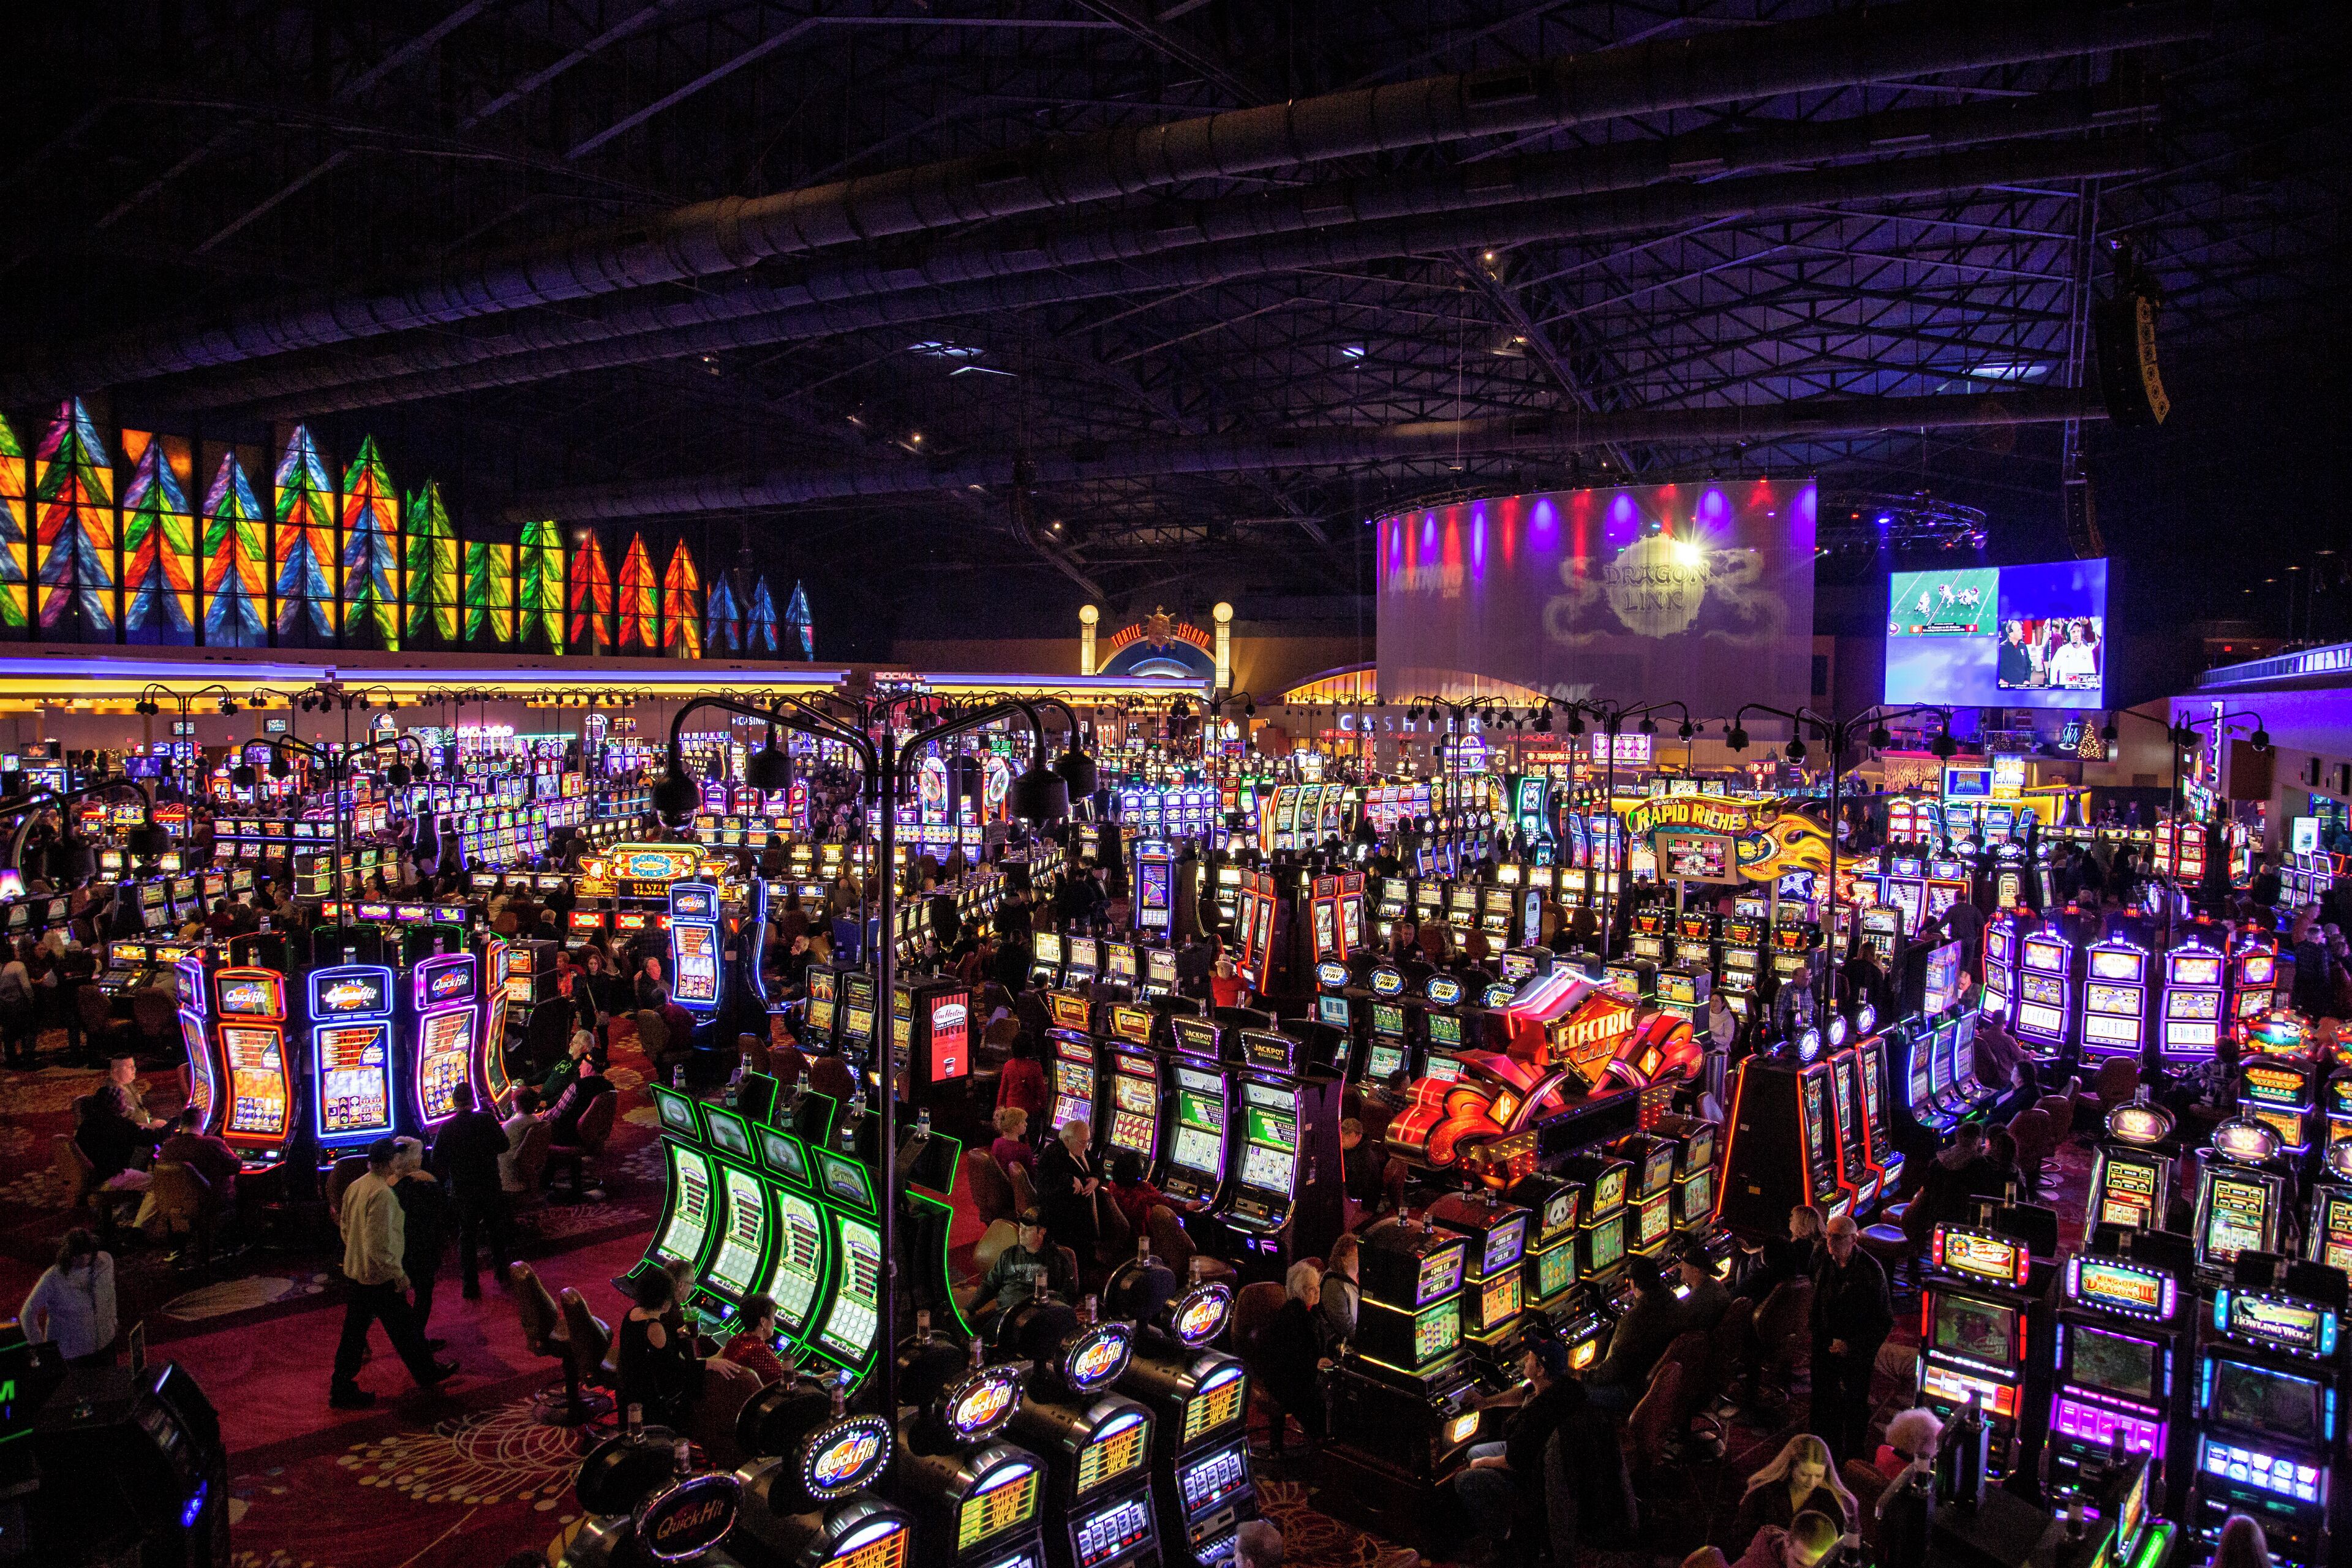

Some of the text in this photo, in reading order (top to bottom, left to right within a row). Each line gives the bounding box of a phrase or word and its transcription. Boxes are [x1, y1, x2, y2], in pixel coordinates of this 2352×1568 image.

[1602, 562, 1711, 586] DRAGON
[1622, 589, 1686, 611] LINK
[1110, 622, 1210, 648] TURTLE ISLAND
[1340, 714, 1480, 734] CASHIER
[1996, 761, 2024, 772] CASH
[1637, 803, 1747, 833] RAPID RICHES
[631, 854, 672, 867] BONUS
[631, 866, 671, 877] POKER
[676, 898, 706, 908] Quick Hit
[1325, 967, 1344, 976] POWER
[1379, 975, 1400, 984] POWER
[432, 974, 469, 991] Quick Hit
[1378, 980, 1395, 989] PAY
[1436, 984, 1457, 992] POWER
[225, 990, 266, 1004] Quick Hit
[325, 988, 377, 1004] Quick Hit
[933, 1008, 966, 1020] Tim Hortons
[1185, 1030, 1213, 1041] JACKPOT
[1558, 1008, 1635, 1052] ELECTRIC
[1254, 1044, 1285, 1057] JACKPOT
[1577, 1038, 1614, 1064] Cash
[1646, 1049, 1656, 1072] 1¢
[2256, 1078, 2294, 1088] MAXI
[1187, 1094, 1205, 1103] JACKPOT
[1256, 1110, 1276, 1118] JACKPOT
[1498, 1094, 1511, 1121] 1¢
[1594, 1189, 1623, 1211] CHINA SHORES
[2097, 1274, 2118, 1285] KING
[2084, 1277, 2155, 1303] DRAGONS III
[1182, 1302, 1223, 1330] Quick Hit
[2233, 1314, 2314, 1340] HOWLING WOLF
[1076, 1341, 1122, 1374] Quick Hit
[958, 1385, 1011, 1423] Quick Hit
[816, 1437, 878, 1477] Quick Hit
[657, 1498, 725, 1541] Quick Hit
